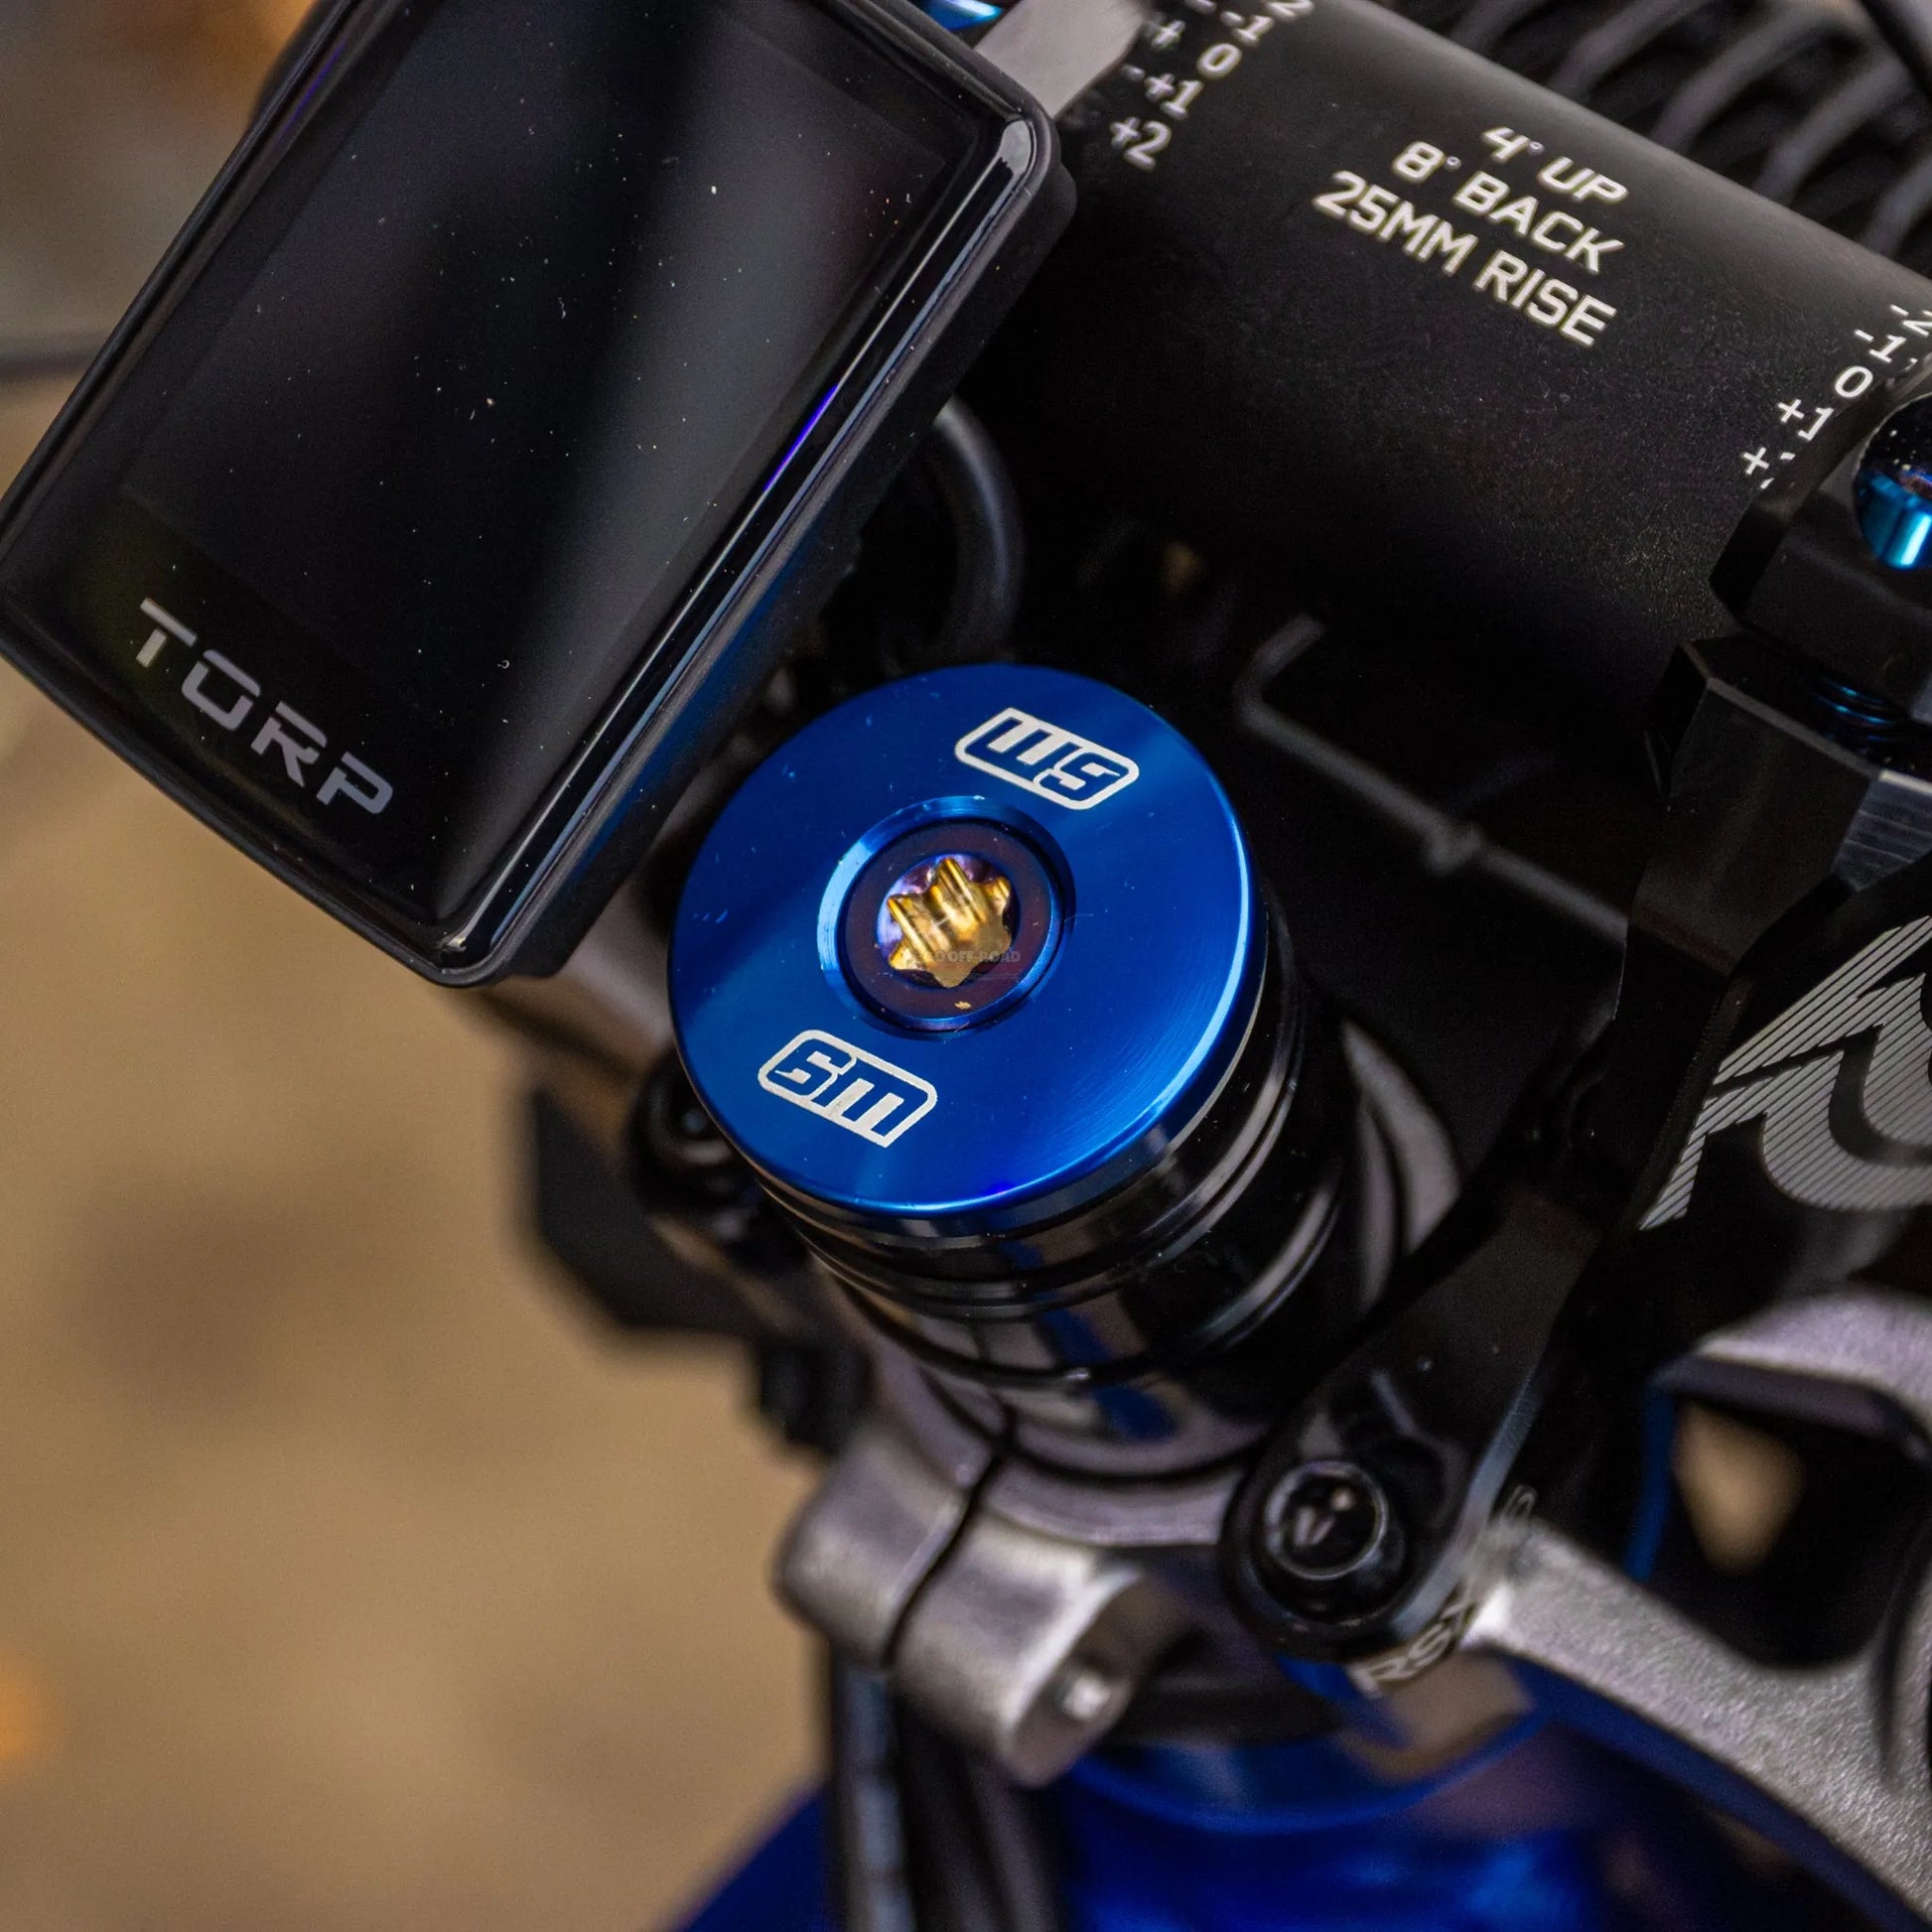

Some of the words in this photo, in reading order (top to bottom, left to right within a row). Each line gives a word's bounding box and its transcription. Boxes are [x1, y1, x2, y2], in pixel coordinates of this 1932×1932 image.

[1196, 43, 1243, 79] 0
[1145, 73, 1203, 120] +1
[1110, 117, 1172, 171] +2
[1538, 156, 1628, 205] UP
[1452, 171, 1624, 275] BACK
[1311, 171, 1478, 277] 25MM
[1474, 250, 1617, 347] RISE
[1855, 329, 1906, 363] -1
[1835, 365, 1874, 399] 0
[136, 597, 393, 815] TORP
